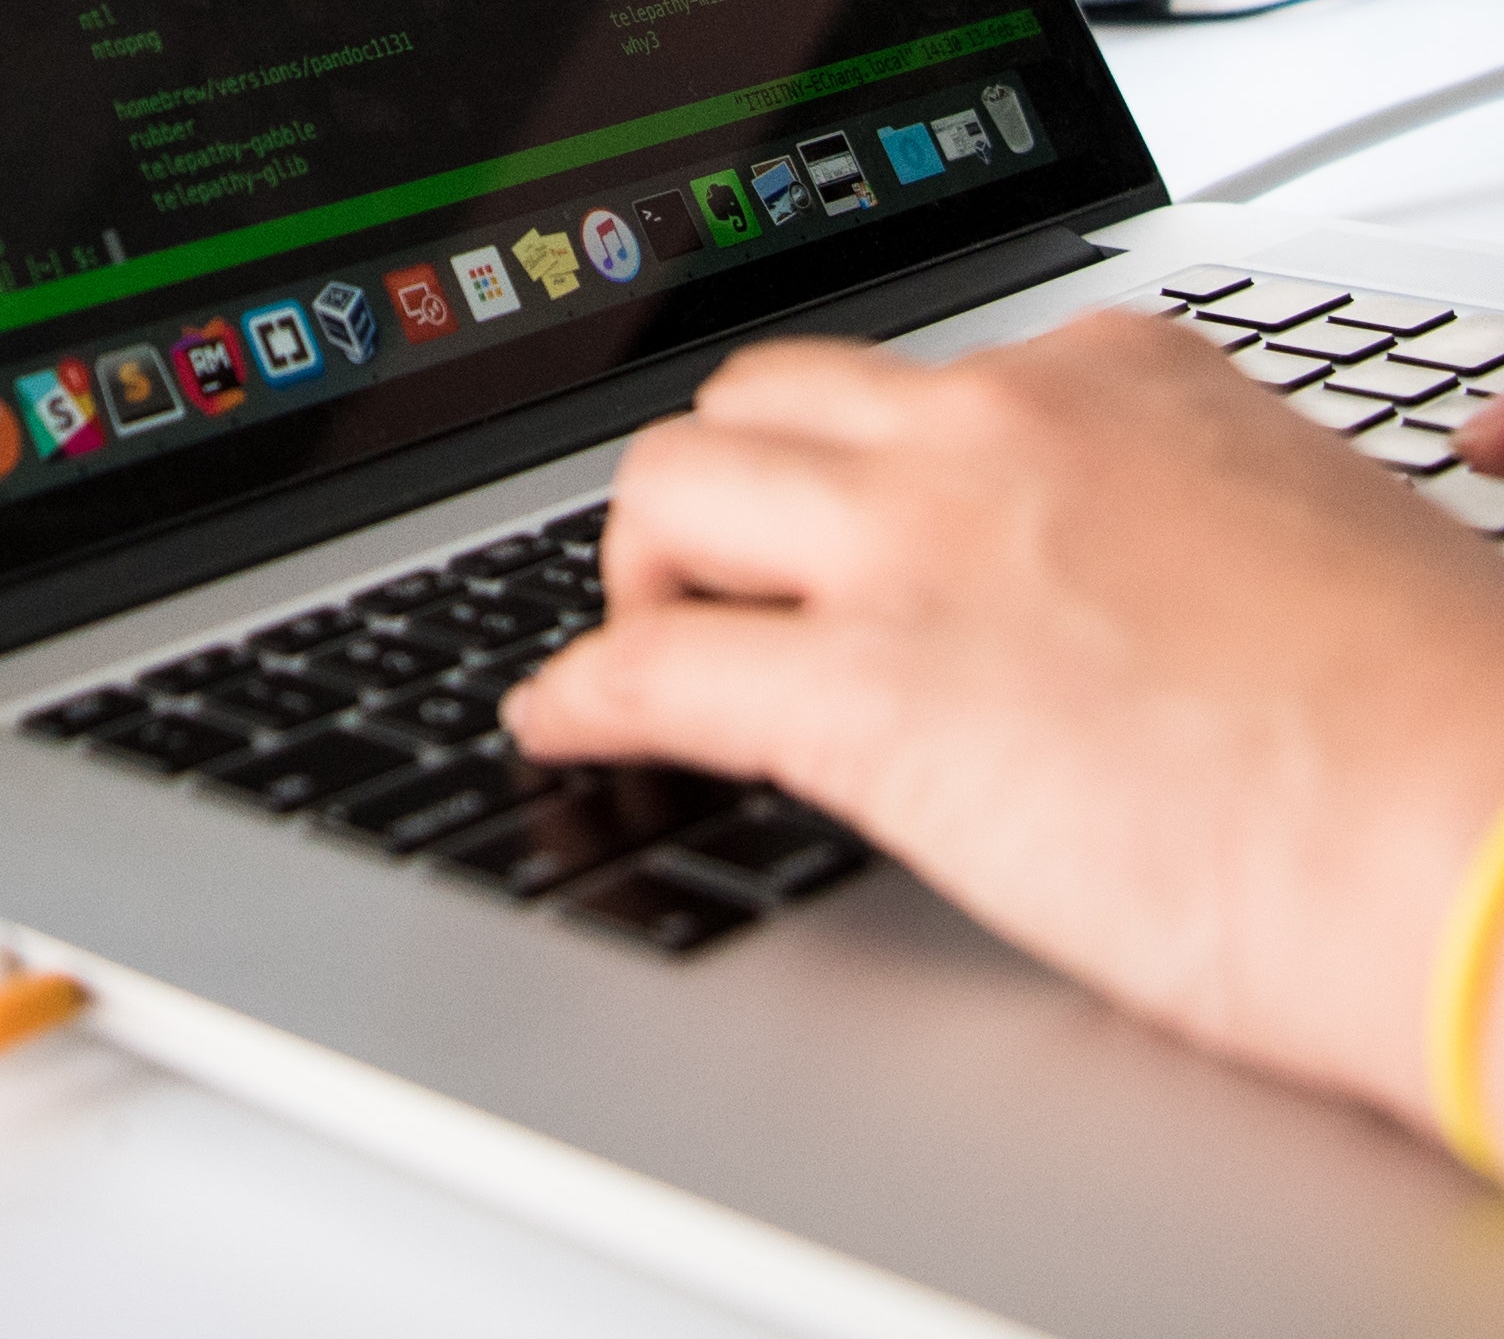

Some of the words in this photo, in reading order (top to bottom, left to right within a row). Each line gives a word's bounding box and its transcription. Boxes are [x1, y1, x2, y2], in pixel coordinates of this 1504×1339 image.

[621, 30, 661, 56] why3
[127, 119, 199, 151] rubber
[150, 152, 309, 212] telepathy-glib
[117, 360, 151, 403] S
